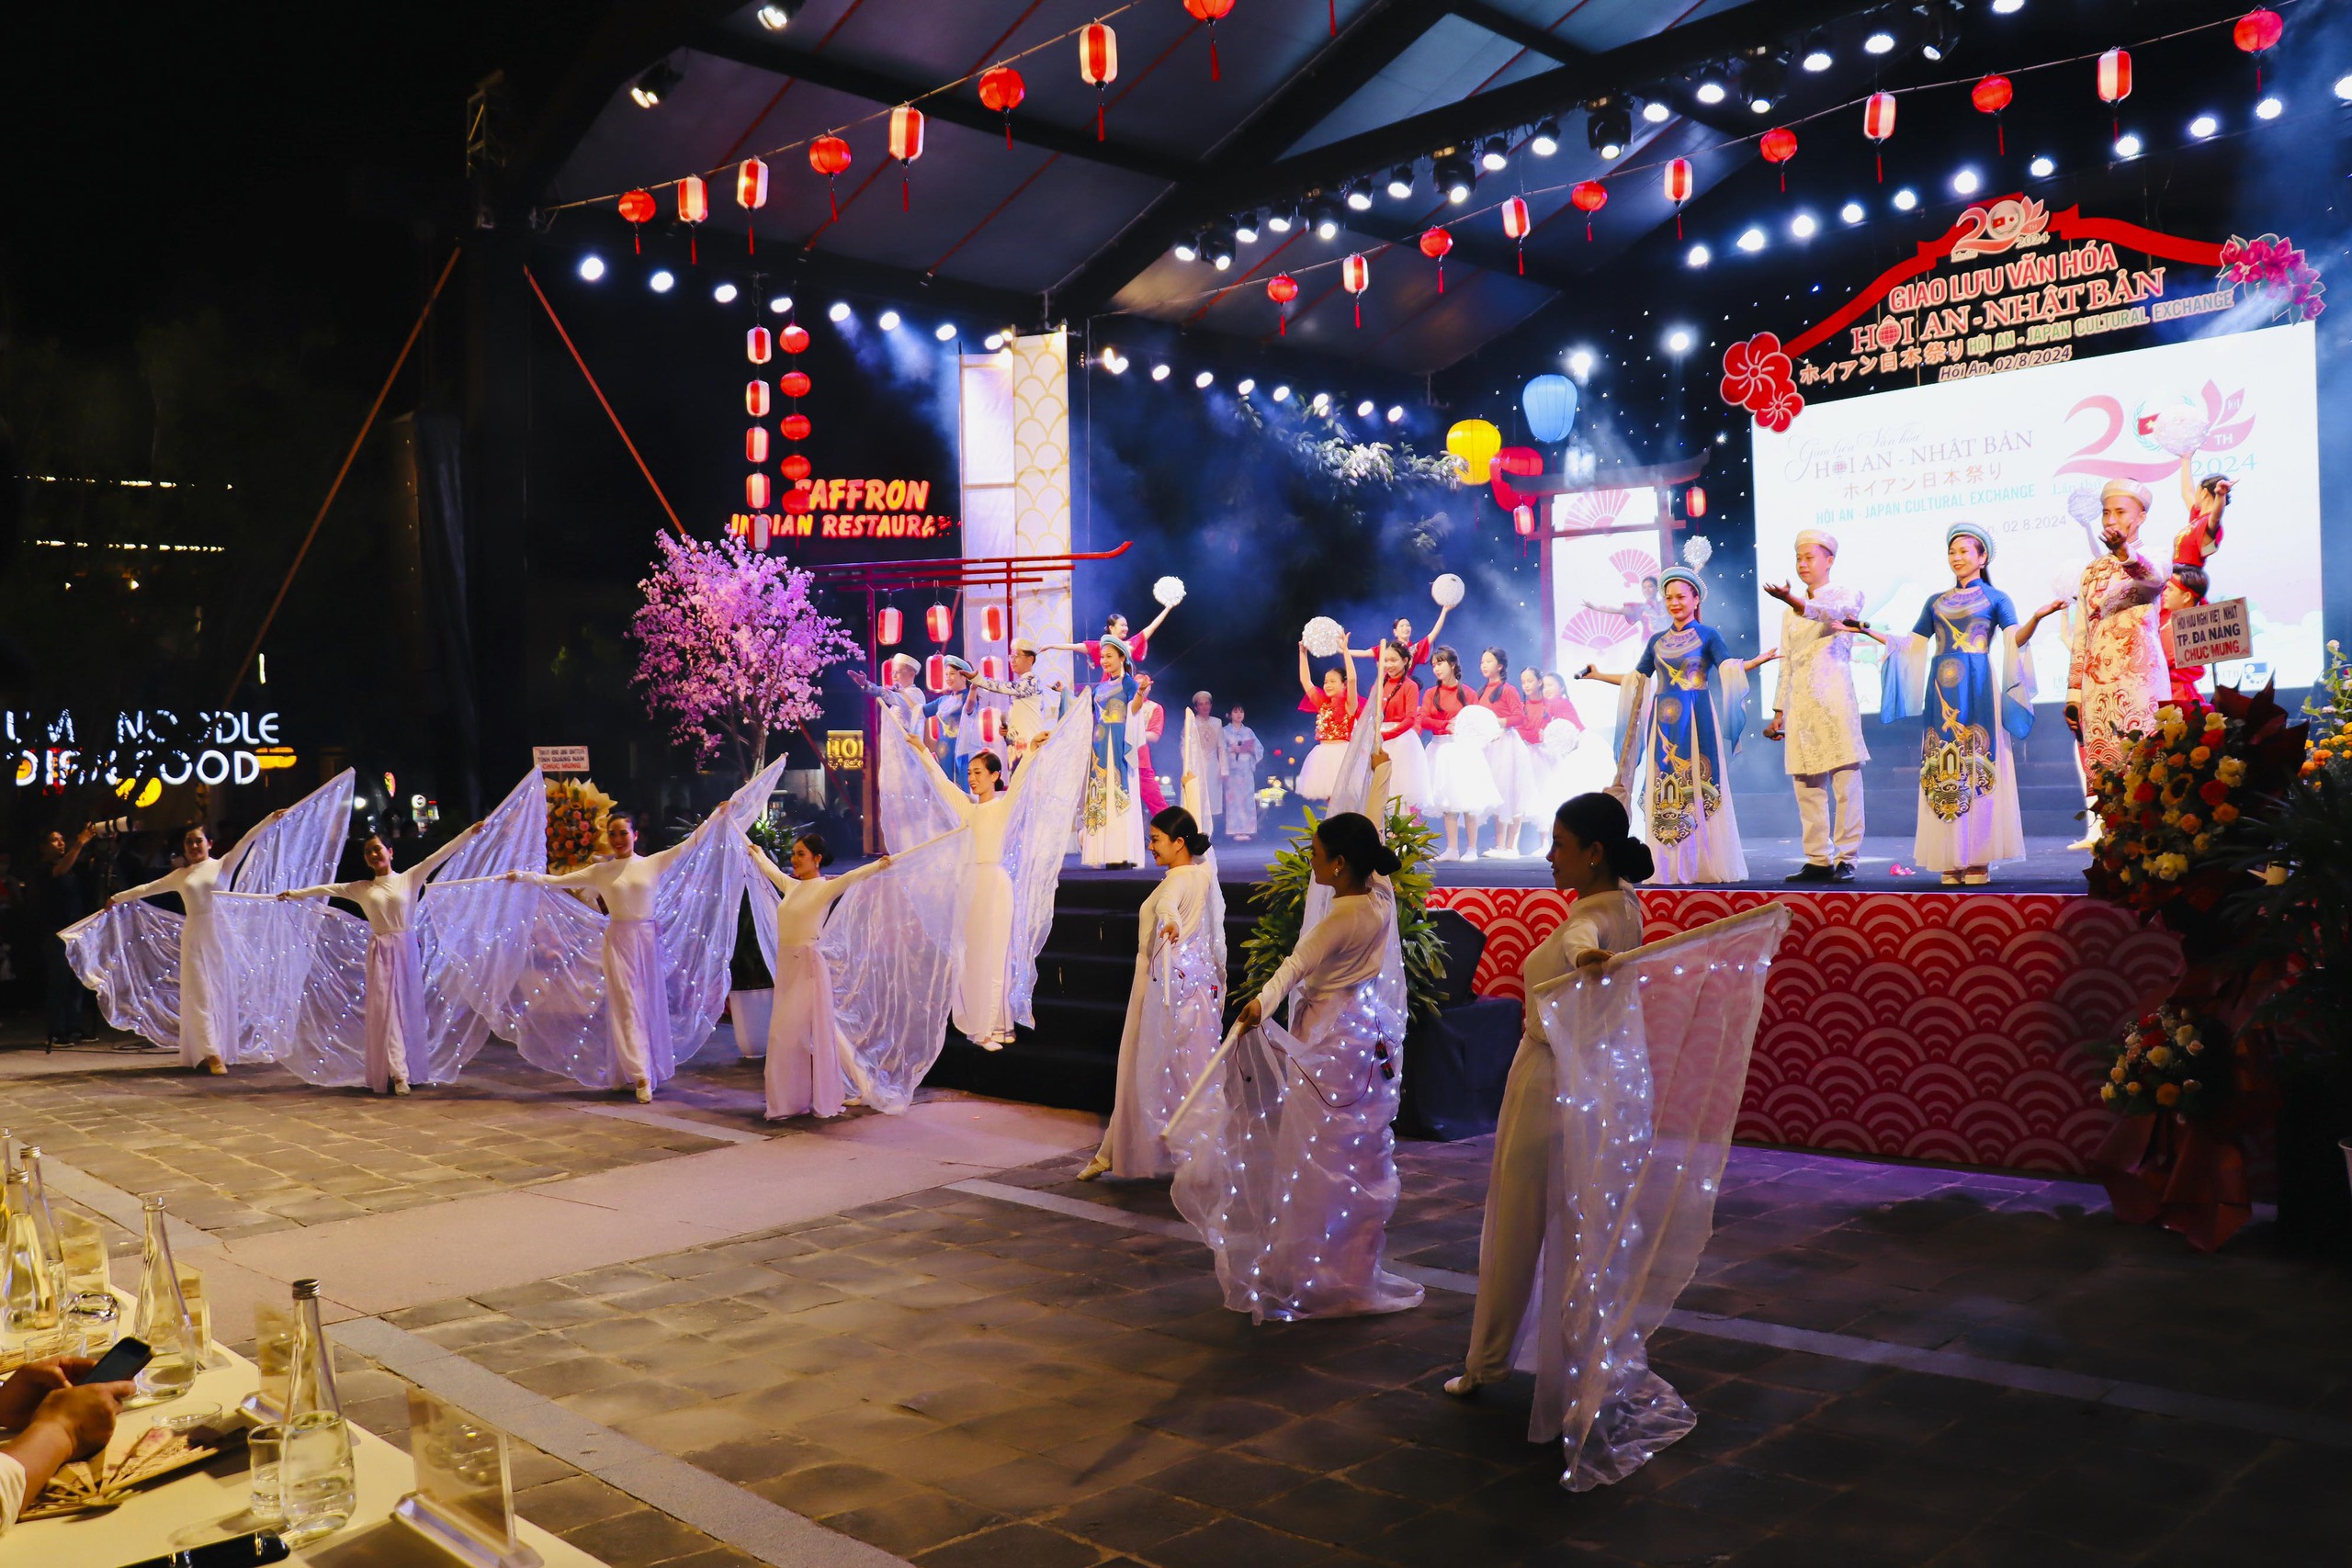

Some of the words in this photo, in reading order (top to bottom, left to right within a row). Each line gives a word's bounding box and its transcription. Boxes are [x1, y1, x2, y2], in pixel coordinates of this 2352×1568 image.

[2018, 231, 2050, 249] 2024
[1889, 280, 1950, 313] GIAO
[1950, 265, 2005, 302] LƯU
[2005, 252, 2061, 291] VĂN
[2061, 240, 2118, 278] HÓA
[1850, 315, 1920, 354] HỘI
[1918, 305, 1973, 342] AN
[1980, 284, 2086, 327] NHẬT
[2086, 267, 2166, 310] BẢN
[1993, 328, 2016, 351] AN
[2025, 321, 2073, 344] JAPAN
[2074, 307, 2151, 338] CULTURAL
[2152, 289, 2235, 322] EXCHANGE
[1799, 338, 1964, 387] ホイアン日本祭り
[1993, 344, 2073, 372] 02/8/2024
[1814, 456, 1856, 480] HỘI
[1860, 451, 1893, 473] AN
[1910, 439, 1978, 467] NHẬT
[1983, 429, 2035, 456] BẢN
[2214, 434, 2234, 446] TH
[1843, 462, 2003, 500] ホイアン日本祭り
[2192, 453, 2257, 478] 2024
[1838, 508, 1855, 523] AN
[1864, 502, 1902, 520] JAPAN
[1904, 492, 1965, 514] CULTURAL
[1969, 483, 2036, 506] EXCHANGE
[729, 513, 814, 536] INIAN
[821, 513, 961, 538] RESTAURA
[2003, 514, 2067, 534] 02.8.2024
